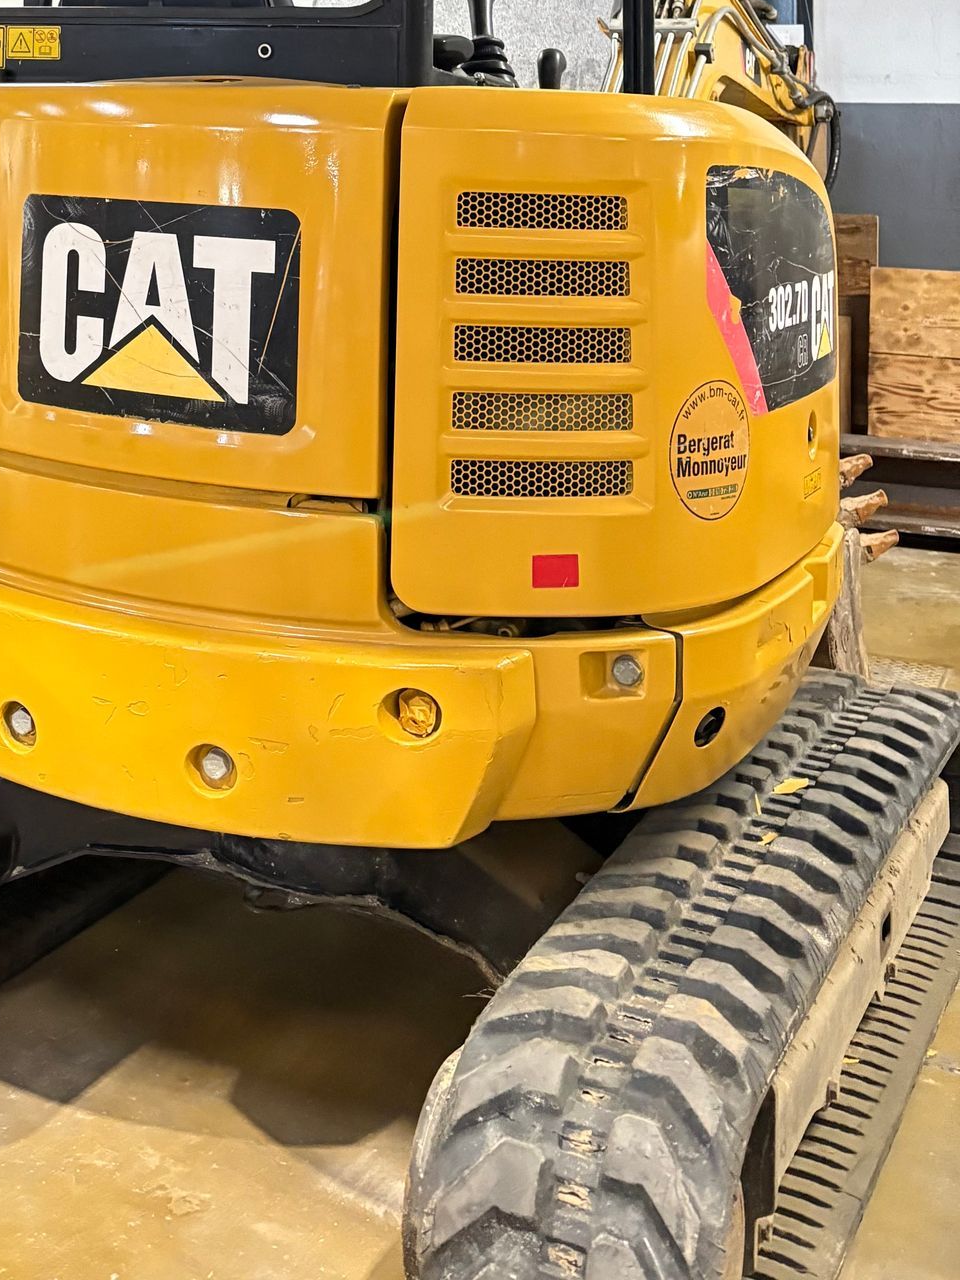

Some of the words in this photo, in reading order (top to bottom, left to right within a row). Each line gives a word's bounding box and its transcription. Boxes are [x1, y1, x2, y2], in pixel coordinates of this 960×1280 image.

[39, 222, 276, 405] CAT
[768, 280, 809, 332] 302.7D
[811, 269, 835, 362] CAT
[682, 385, 745, 421] www.bm-cat.fr
[676, 430, 735, 456] Bergerat
[676, 453, 747, 478] Monnoyeur
